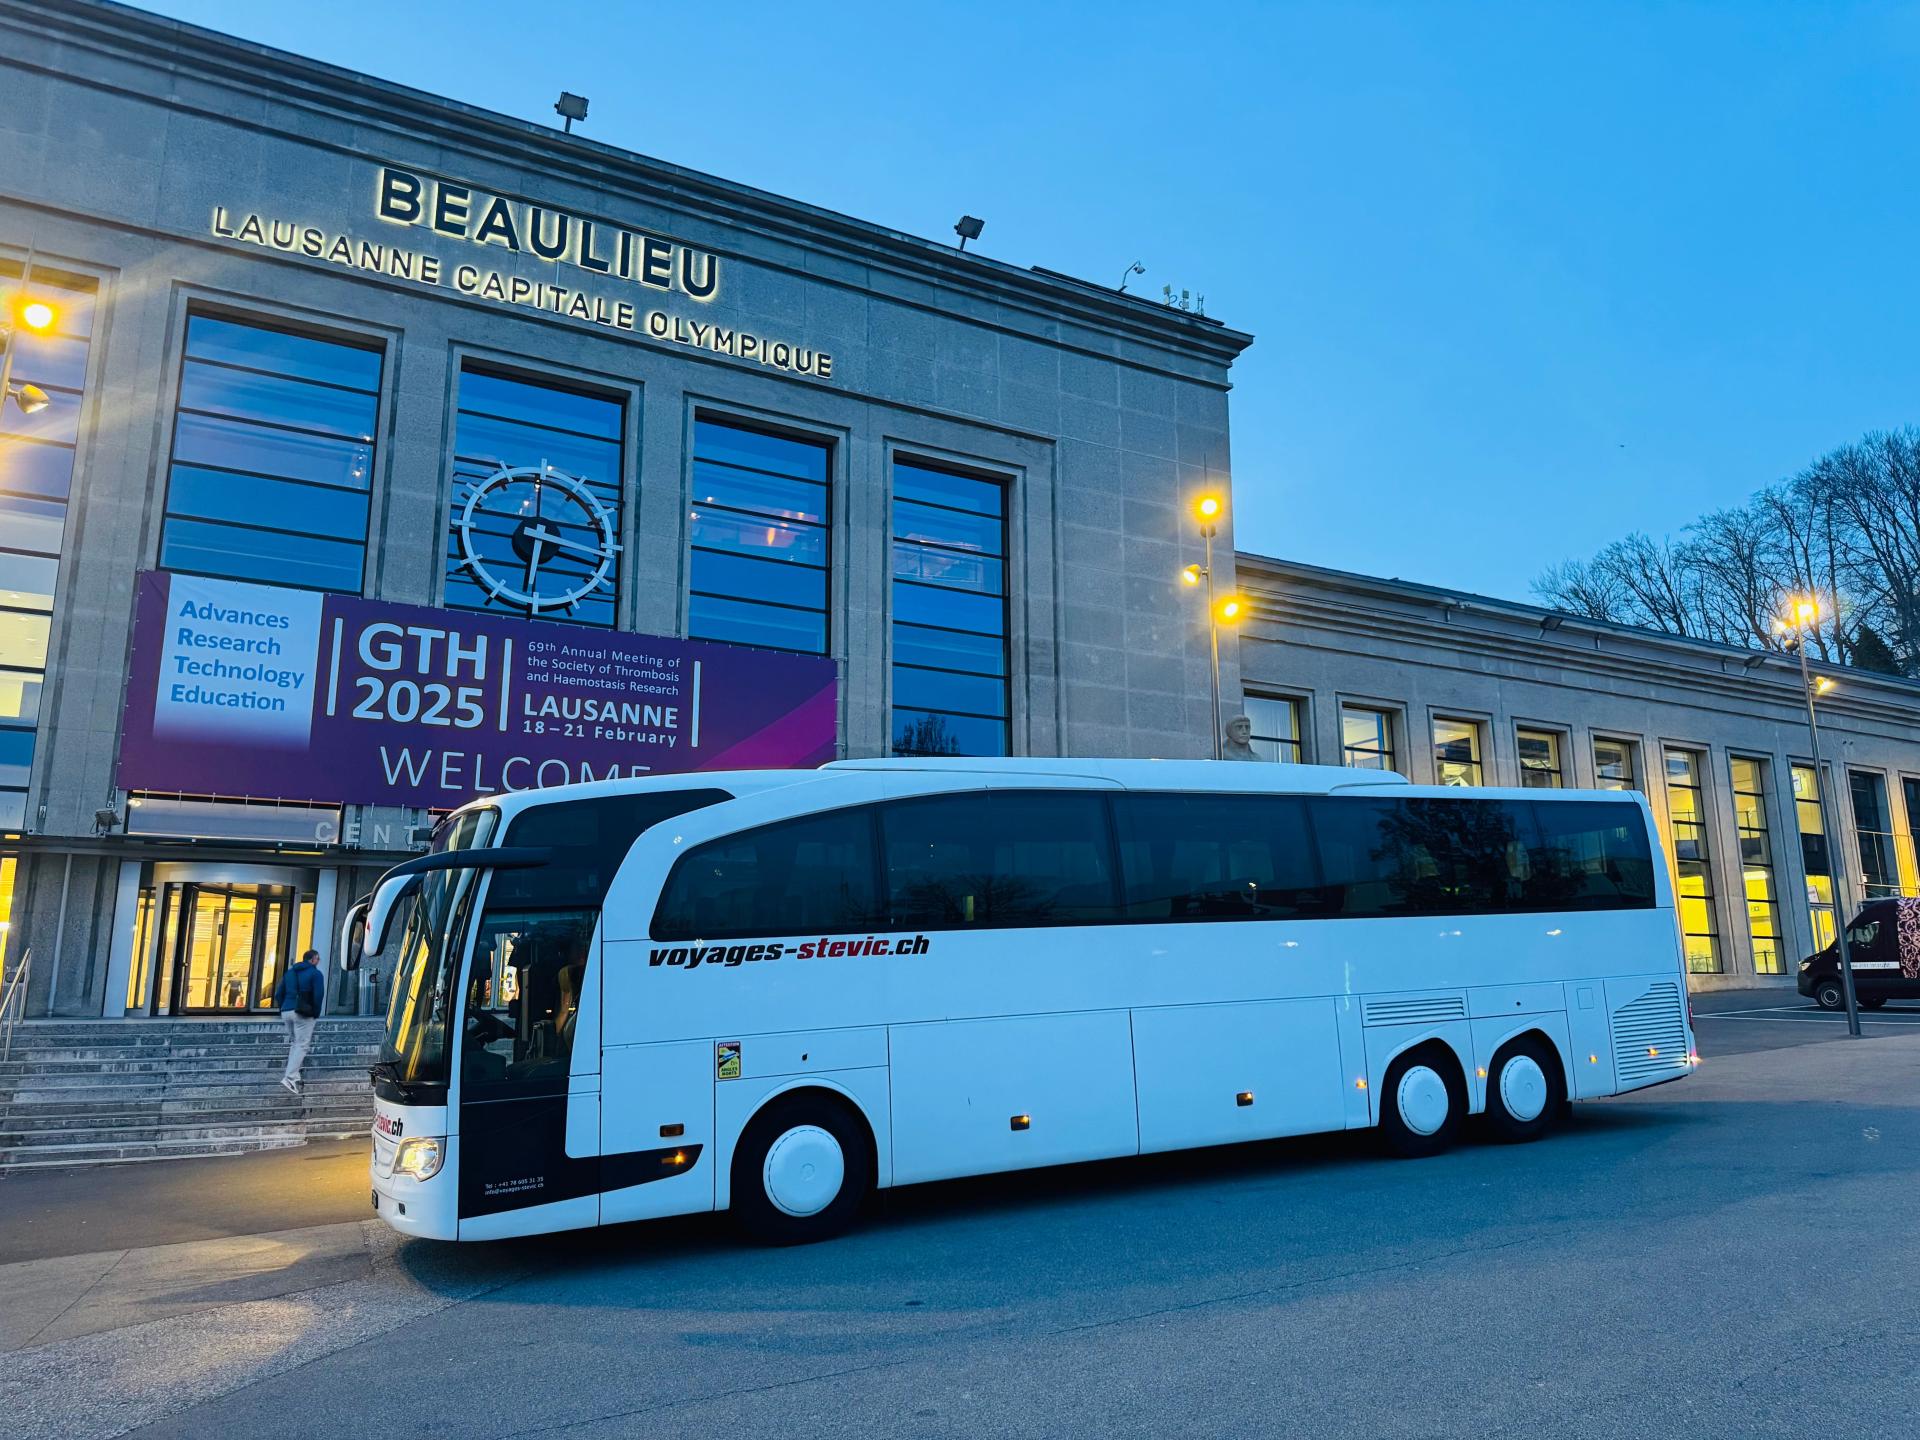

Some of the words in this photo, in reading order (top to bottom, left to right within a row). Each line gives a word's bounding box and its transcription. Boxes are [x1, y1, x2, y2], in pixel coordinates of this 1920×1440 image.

[380, 167, 717, 298] BEAULIEU
[214, 206, 439, 284] LAUSANNE
[457, 265, 633, 329] CAPITALE
[650, 311, 832, 378] OLYMPIQUE
[179, 600, 290, 629] Advances
[177, 627, 281, 656] Research
[358, 622, 488, 680] GTH
[528, 641, 556, 653] 69th
[561, 645, 606, 660] Annual
[611, 650, 663, 668] Meeting
[668, 658, 681, 668] of
[173, 655, 305, 689] Technology
[527, 656, 548, 668] the
[551, 658, 596, 675] Society
[598, 664, 612, 674] of
[614, 665, 680, 682] Thrombosis
[170, 683, 286, 712] Education
[526, 672, 549, 683] and
[553, 673, 626, 690] Haemostasis
[629, 681, 679, 696] Research
[352, 676, 484, 728] 2025
[524, 693, 679, 729] LAUSANNE
[594, 726, 677, 748] February
[314, 821, 421, 845] CENT
[648, 935, 931, 970] voyages-stevic.ch
